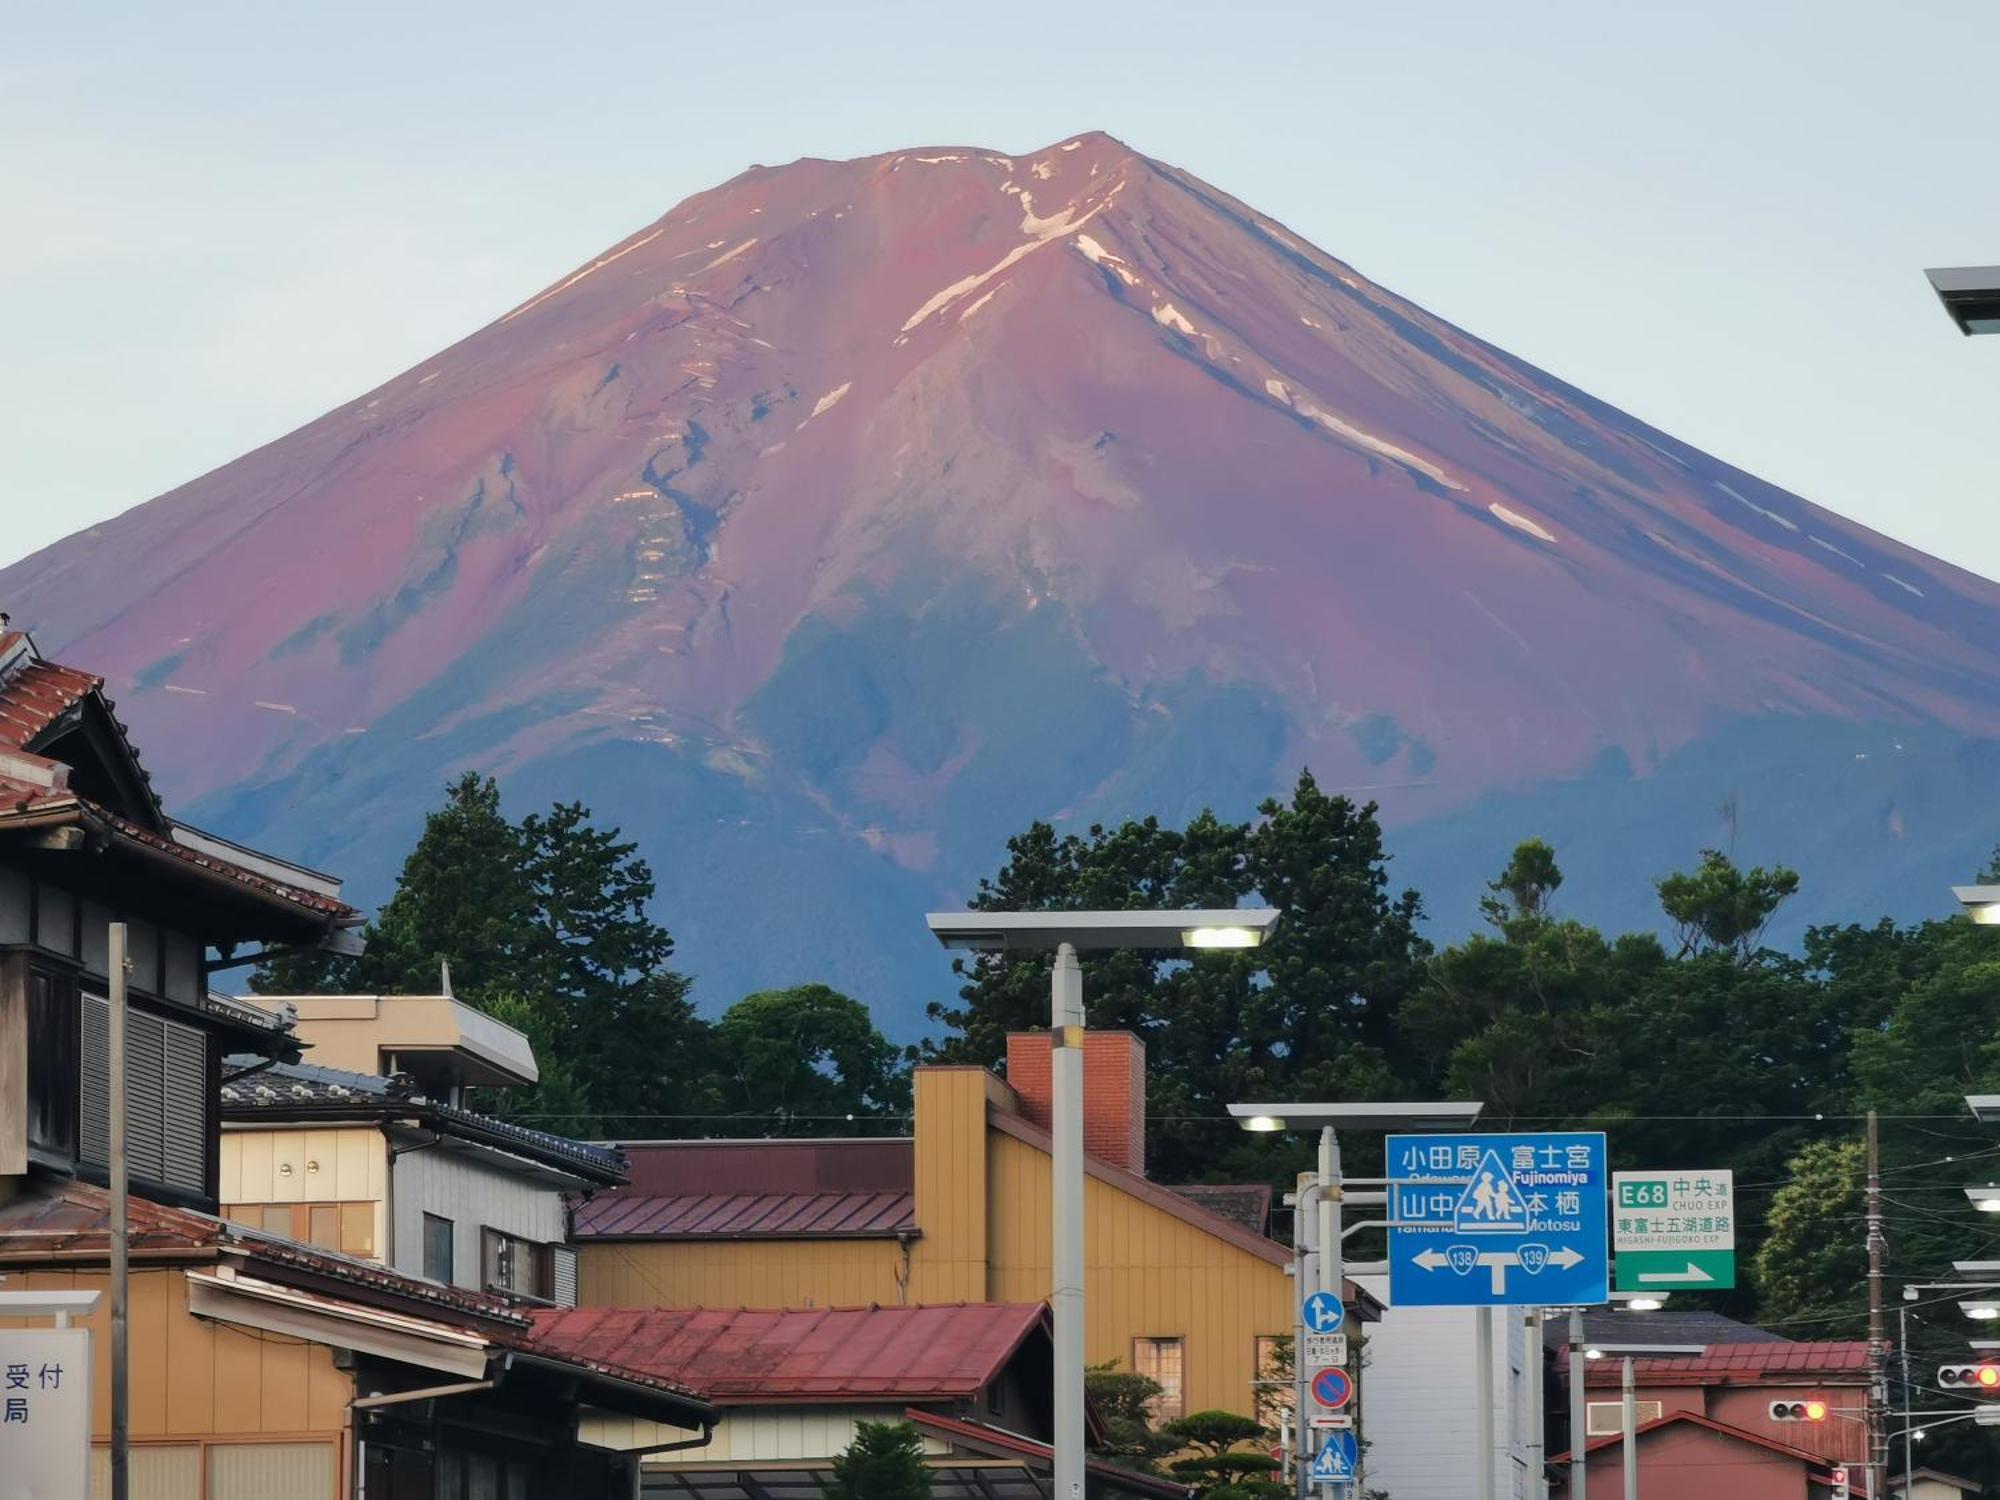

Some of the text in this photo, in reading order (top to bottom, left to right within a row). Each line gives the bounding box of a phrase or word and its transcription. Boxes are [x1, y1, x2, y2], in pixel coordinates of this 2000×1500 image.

[1402, 1145, 1481, 1170] 小田原
[1511, 1144, 1591, 1169] 富士宮
[1512, 1170, 1588, 1187] Fujinomiya
[1672, 1178, 1728, 1197] 中央道
[1525, 1191, 1580, 1217] 本栖
[1621, 1185, 1665, 1204] E68
[1402, 1192, 1462, 1218] 山中
[1672, 1200, 1727, 1211] CHUO EXP
[1617, 1216, 1729, 1234] 東富士五湖道路
[1704, 1234, 1720, 1244] EXP
[1453, 1252, 1472, 1266] 138
[1523, 1250, 1543, 1265] 139
[6, 1363, 64, 1389] 受付
[4, 1398, 28, 1423] 局
